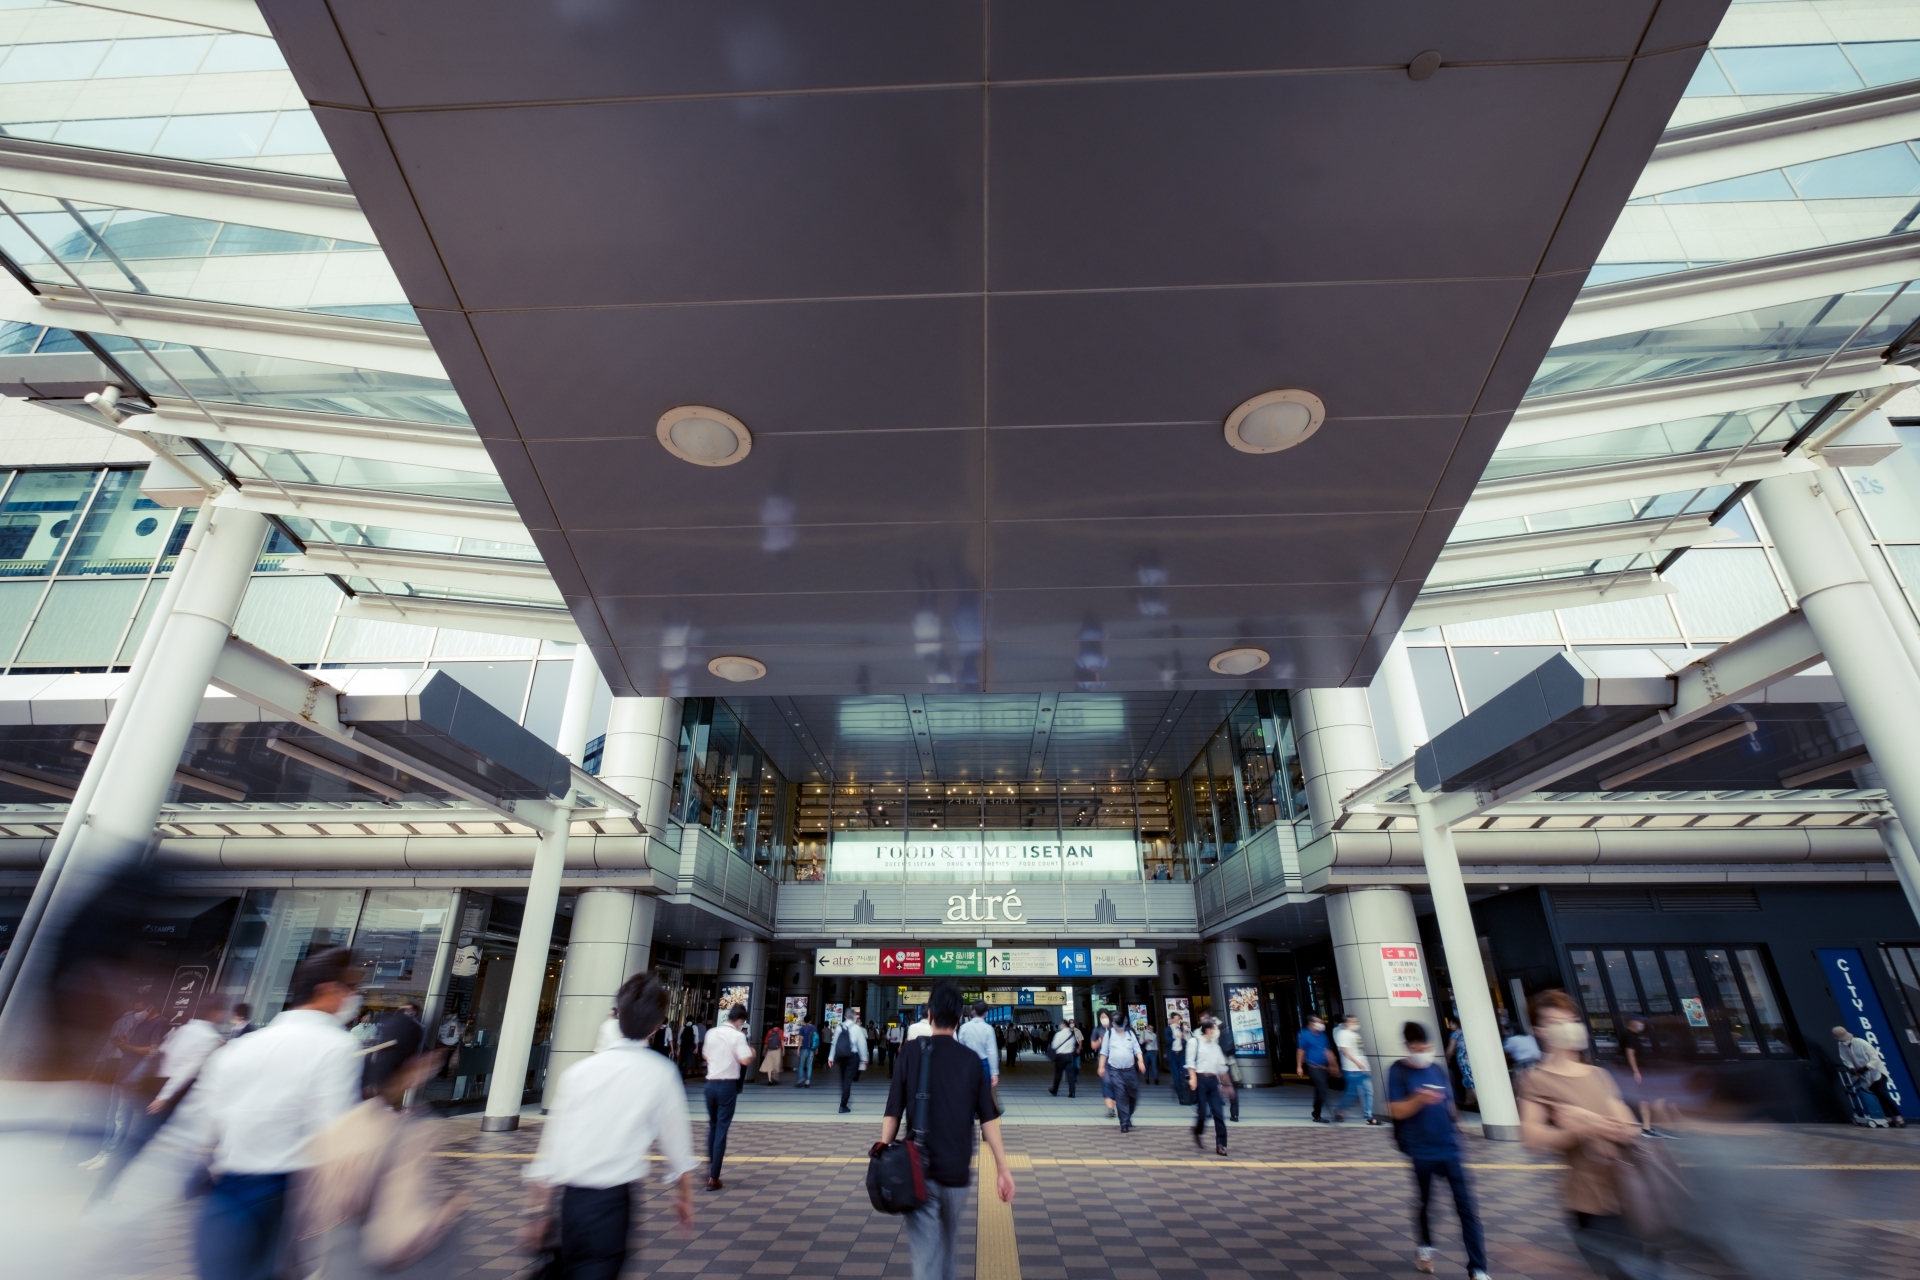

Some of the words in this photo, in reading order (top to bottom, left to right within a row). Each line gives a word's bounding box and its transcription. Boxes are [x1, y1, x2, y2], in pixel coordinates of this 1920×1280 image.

[876, 846, 934, 859] FOOD
[1023, 845, 1093, 858] ISETAN
[946, 888, 1023, 922] atré
[832, 954, 854, 966] atré
[940, 952, 954, 960] JR
[1118, 956, 1139, 966] atré
[1836, 958, 1864, 1012] CITY
[1859, 1016, 1901, 1105] BAKRY
